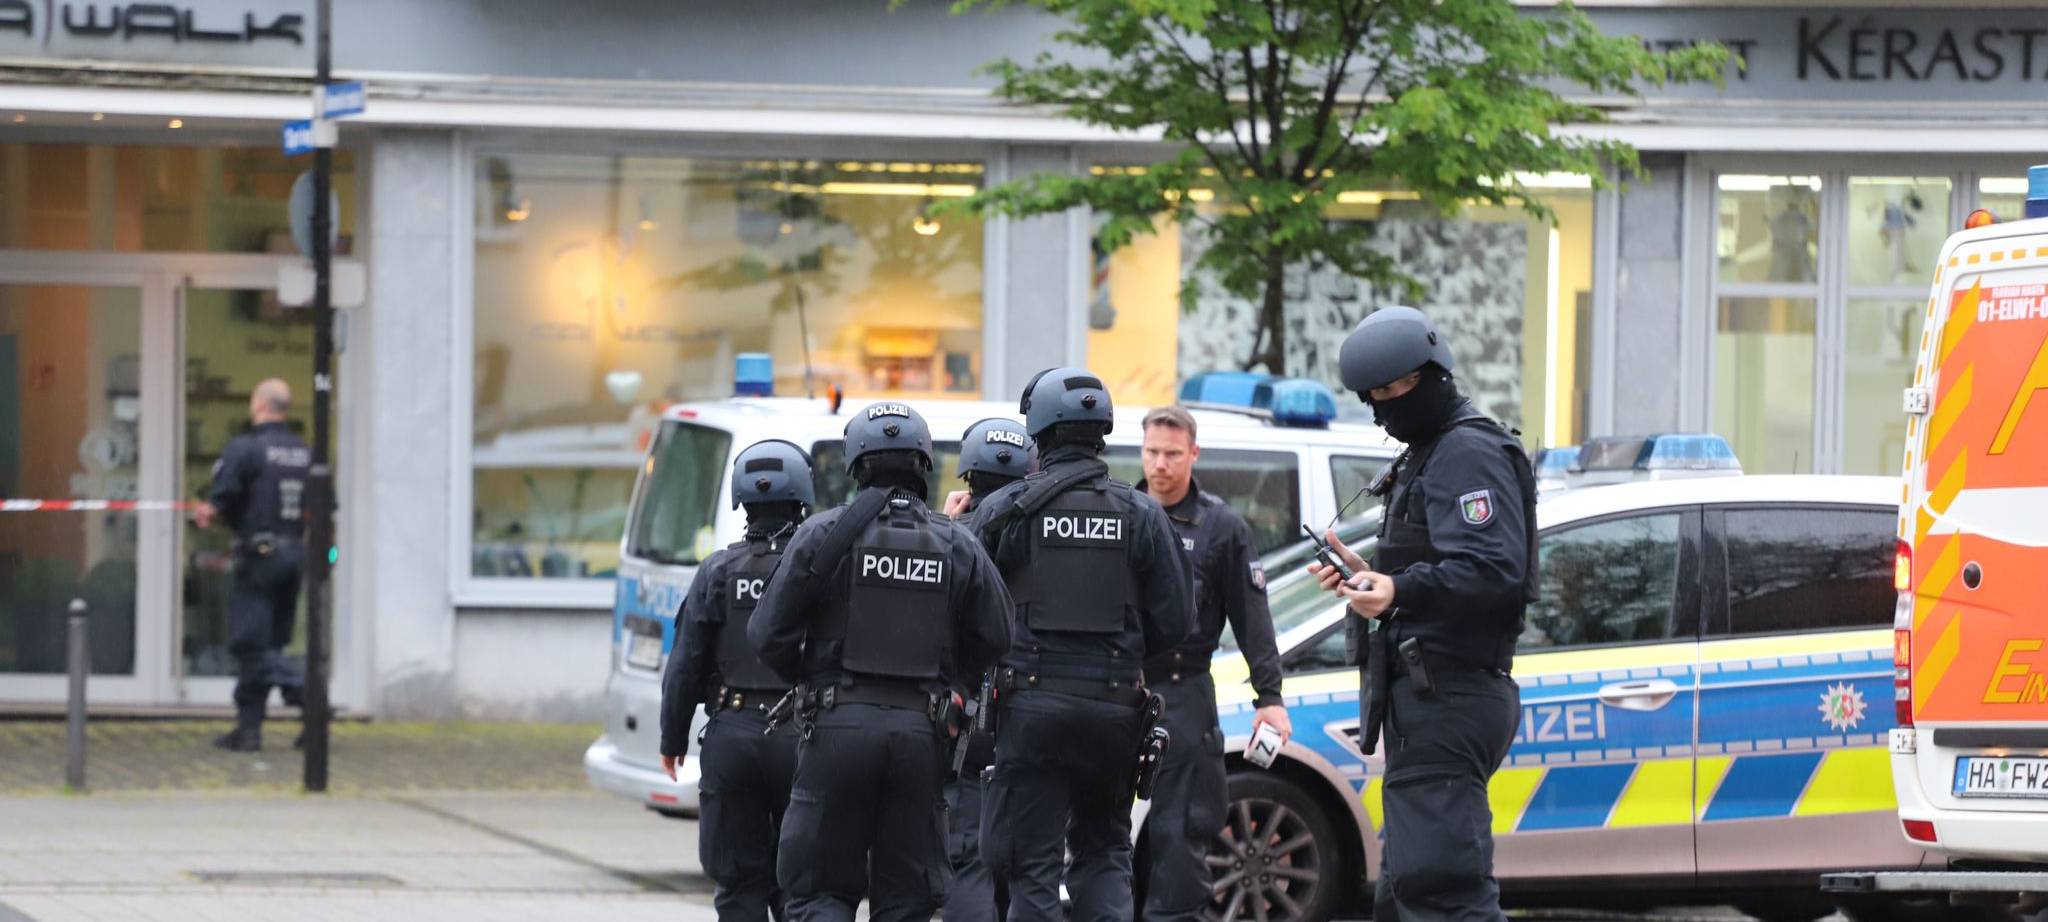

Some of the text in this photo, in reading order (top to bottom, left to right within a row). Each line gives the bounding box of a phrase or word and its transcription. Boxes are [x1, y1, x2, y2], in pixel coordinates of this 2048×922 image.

[1797, 16, 2048, 81] KÉRAST
[869, 405, 908, 419] POLIZEI
[987, 430, 1024, 446] POLIZEI
[1043, 516, 1121, 540] POLIZEI
[862, 554, 943, 584] POLIZEI
[1969, 762, 1996, 789] HA
